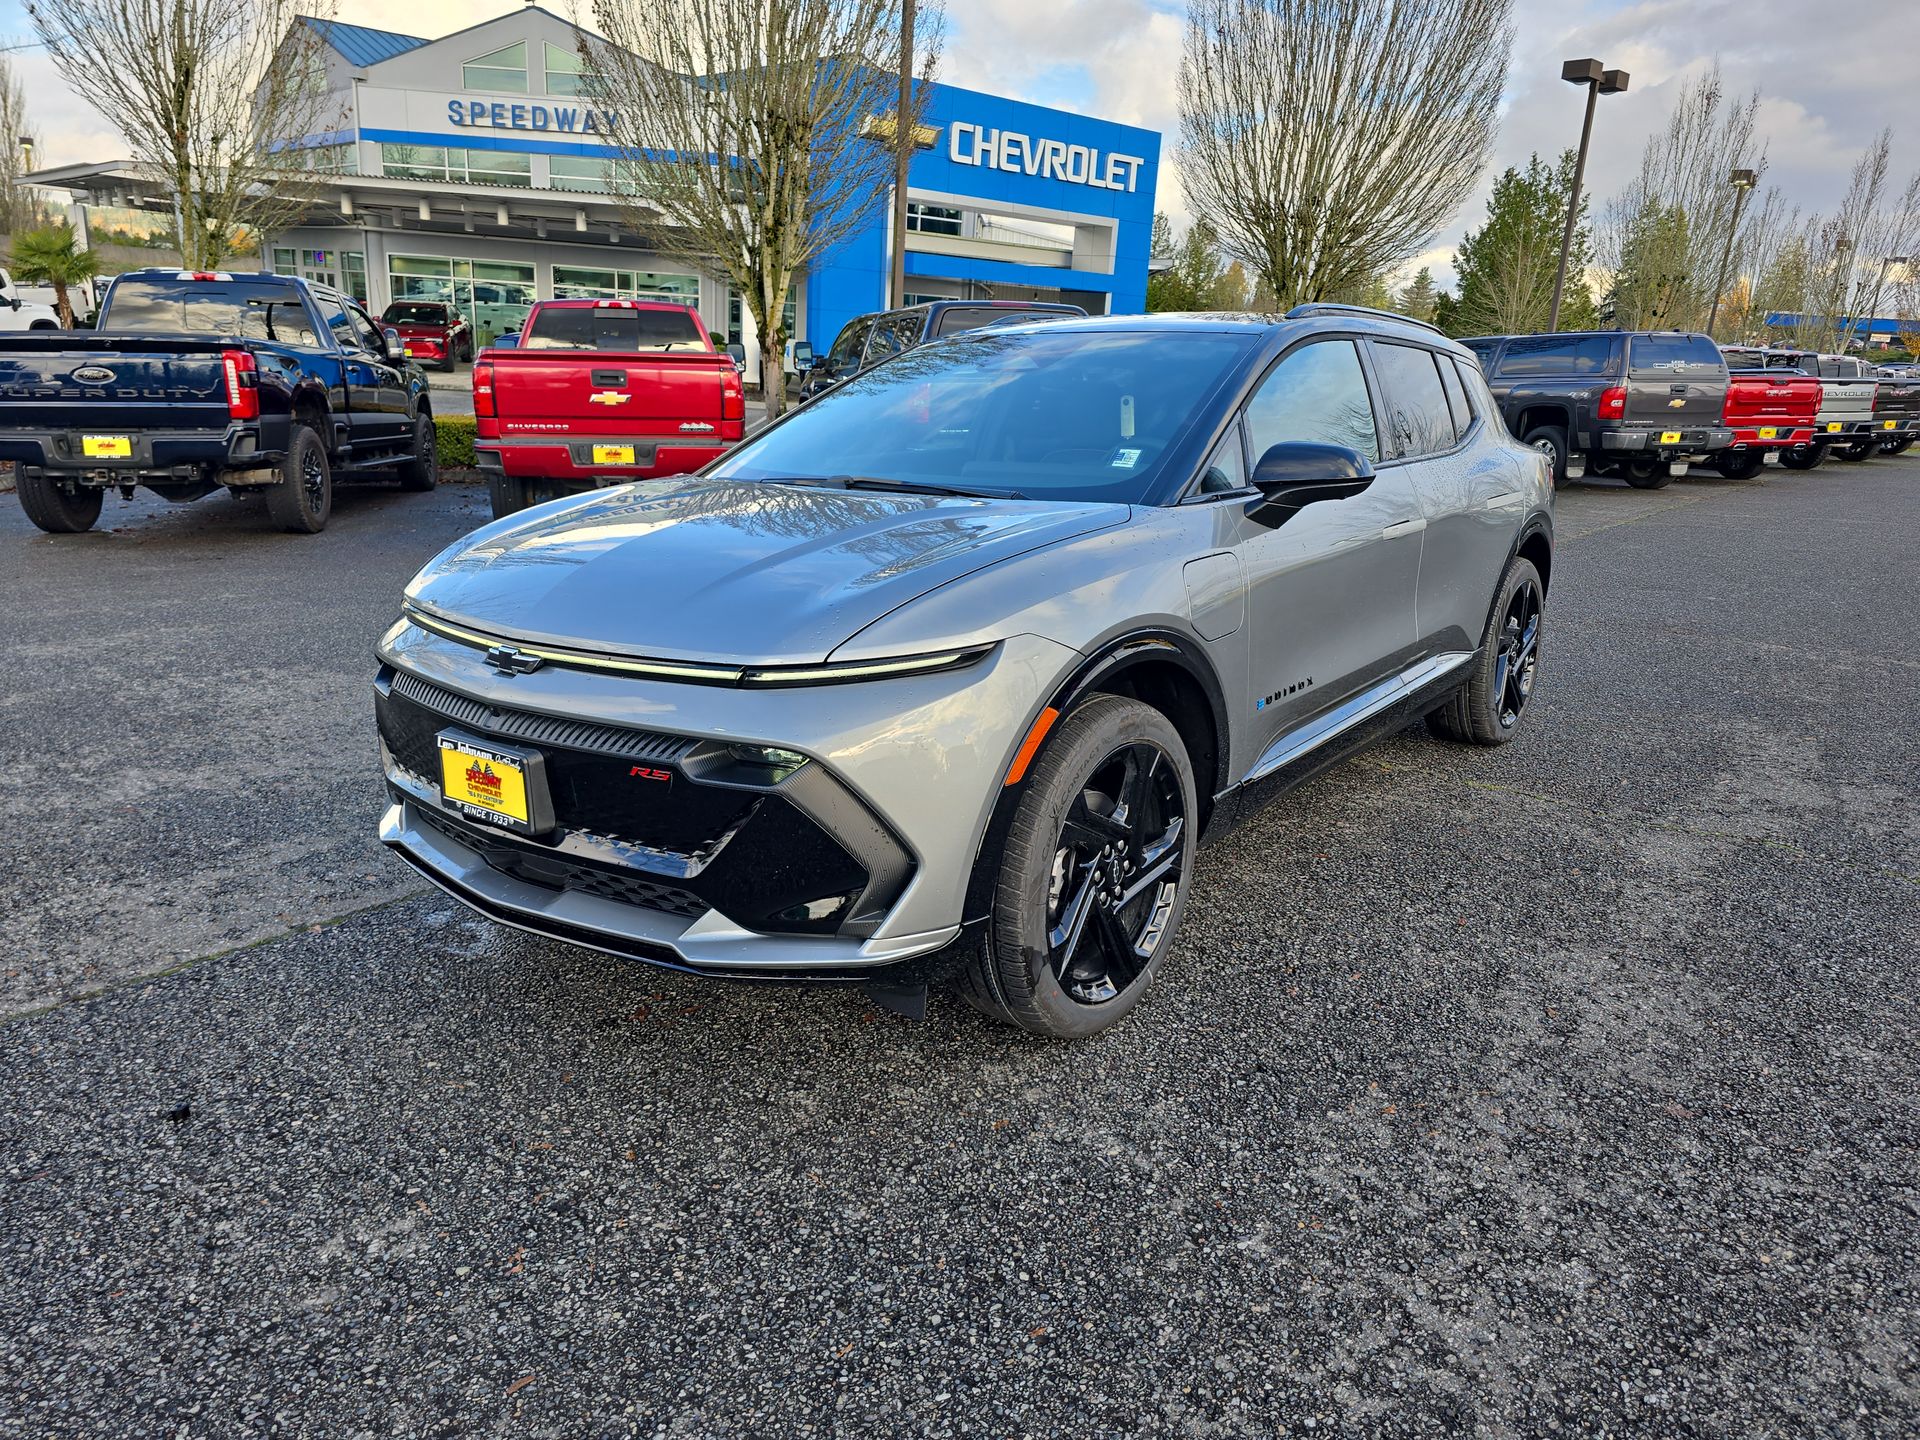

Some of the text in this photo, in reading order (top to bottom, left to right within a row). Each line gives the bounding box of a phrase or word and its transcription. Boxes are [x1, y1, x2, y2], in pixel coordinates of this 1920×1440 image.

[448, 100, 619, 134] SPEEDWAY
[950, 121, 1144, 193] CHEVROLET
[0, 388, 213, 398] UPER DUTY
[1256, 676, 1314, 711] EQUINOX
[629, 765, 671, 781] RS
[463, 805, 508, 826] SINCE 1933
